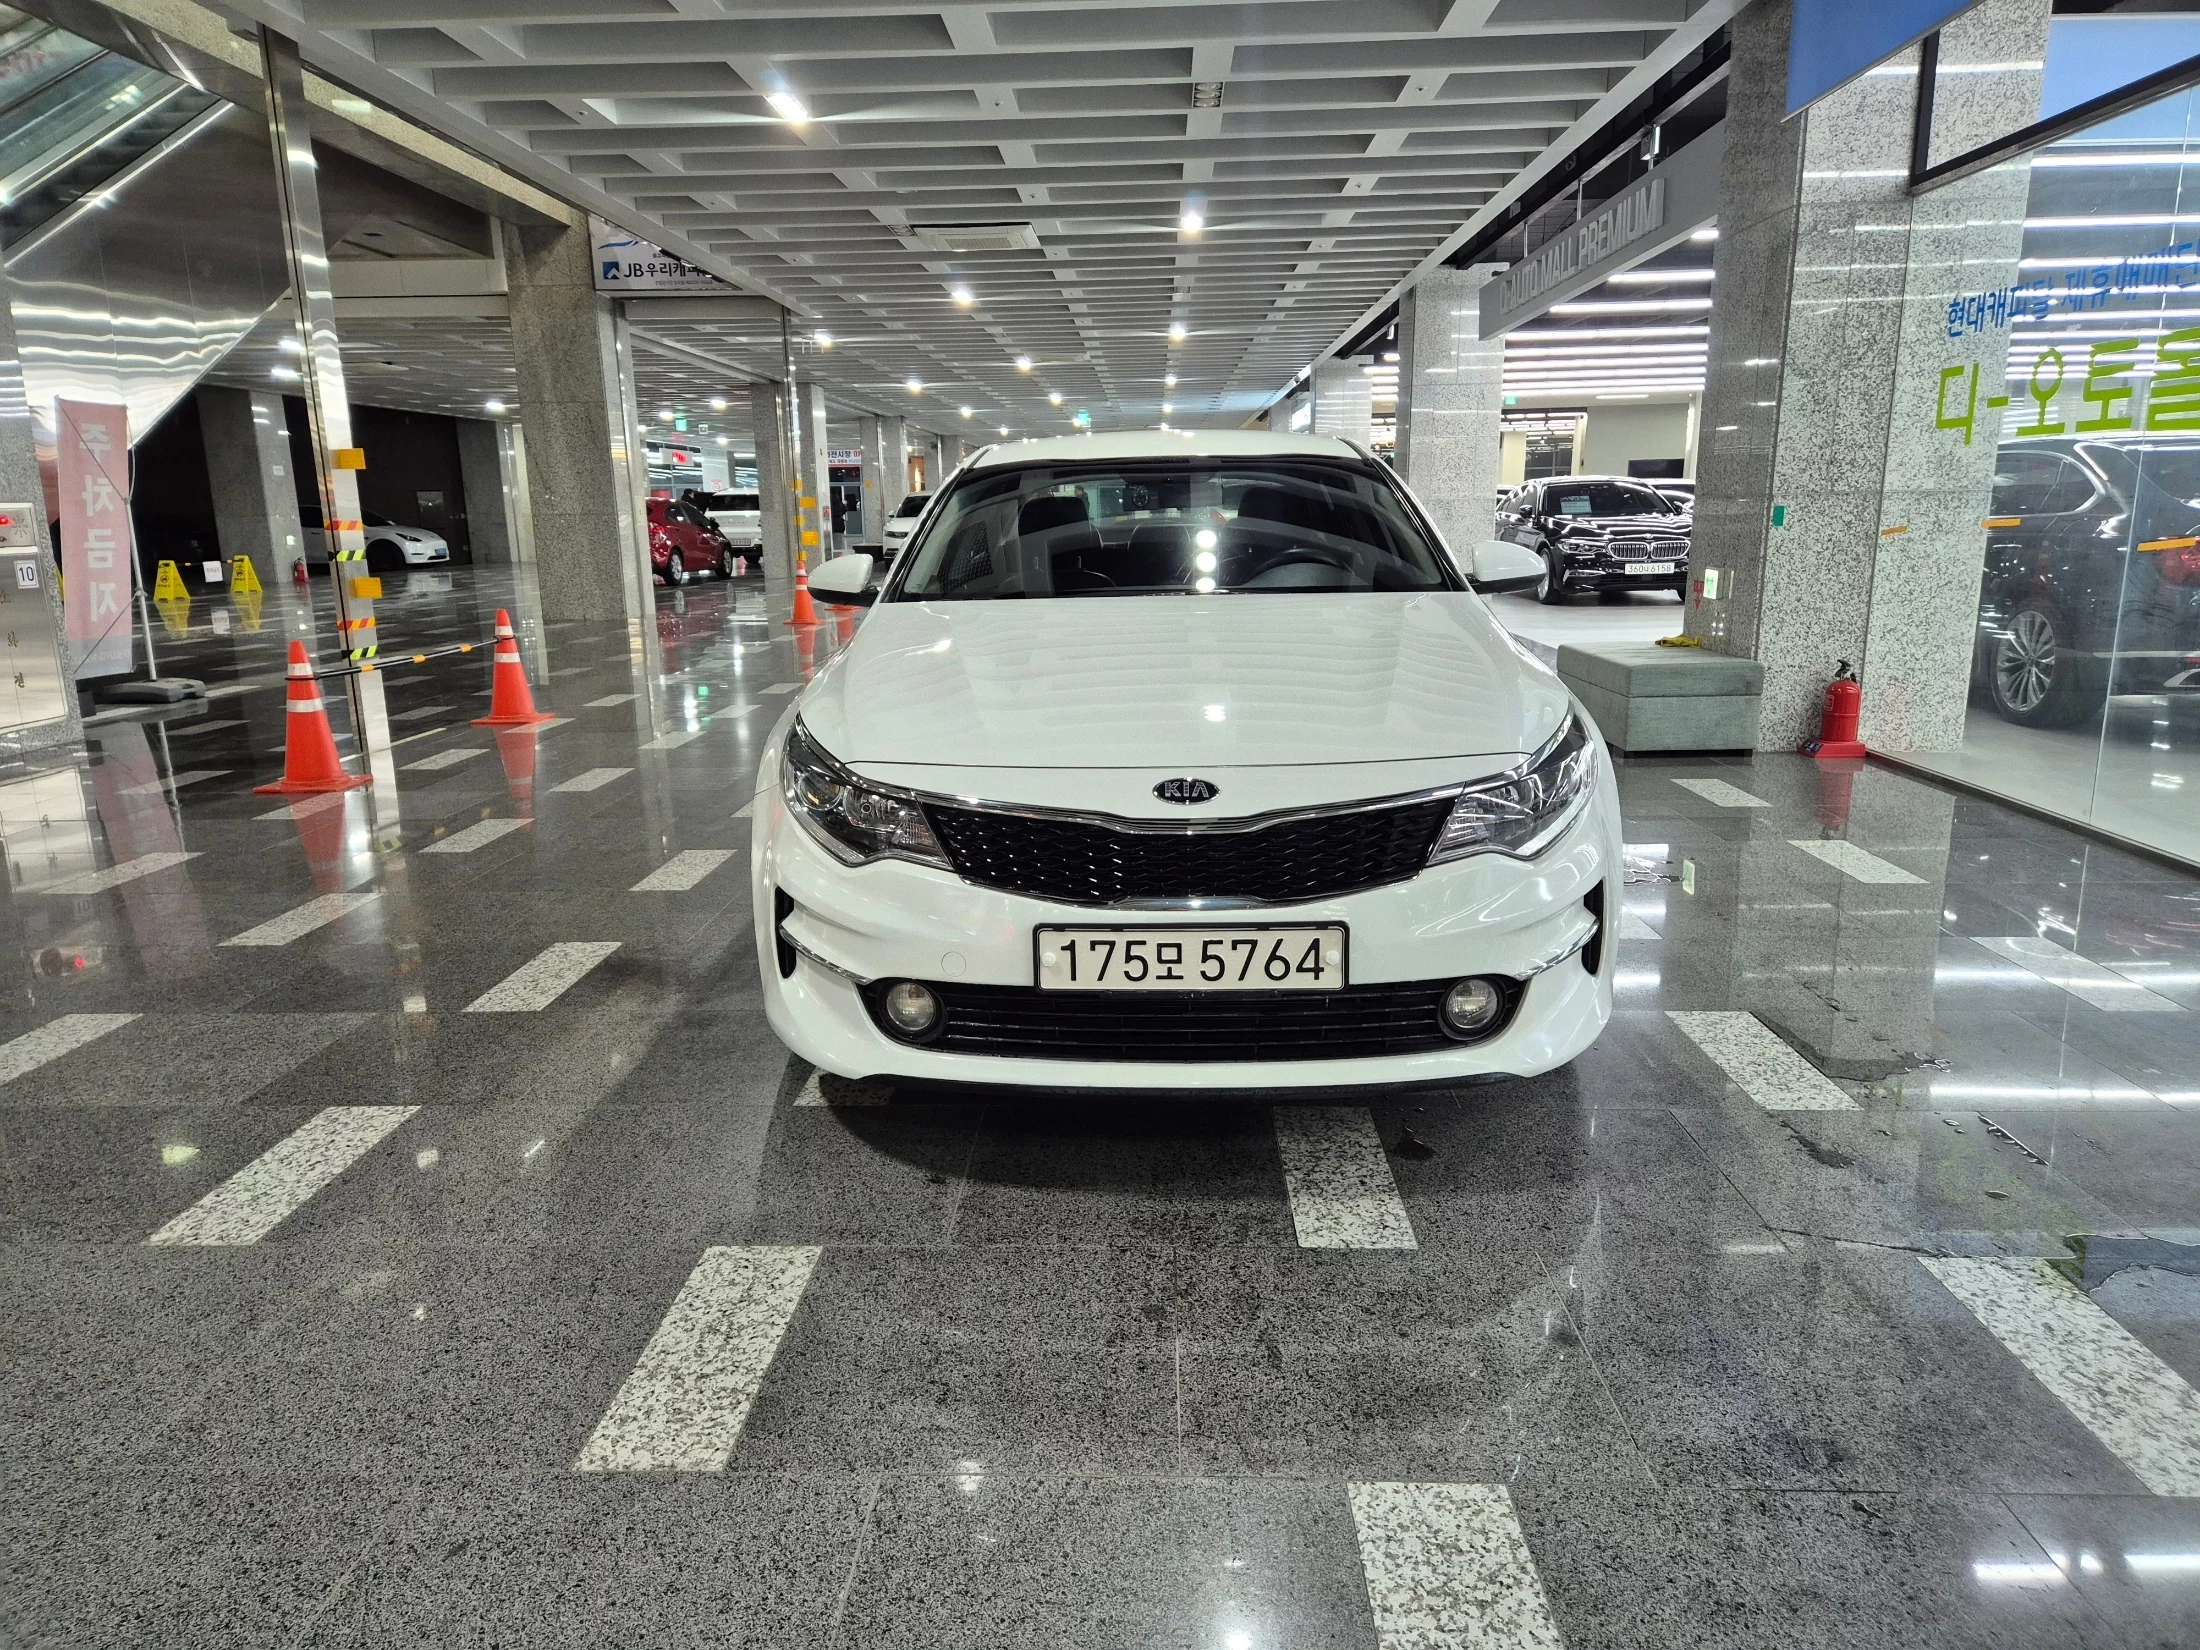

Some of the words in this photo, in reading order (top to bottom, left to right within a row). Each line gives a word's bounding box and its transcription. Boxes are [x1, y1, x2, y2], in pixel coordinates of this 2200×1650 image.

[1498, 259, 1539, 314] D-AUTO
[1541, 237, 1577, 291] MALL
[1578, 178, 1666, 270] PREMIUM
[623, 262, 704, 278] JB우리캐피
[1948, 276, 2054, 338] 현대캐피탈
[18, 566, 34, 582] 10
[1651, 564, 1671, 572] 6158
[1164, 781, 1209, 797] KIA
[1060, 939, 1184, 981] 175모
[1200, 937, 1324, 981] 5764
